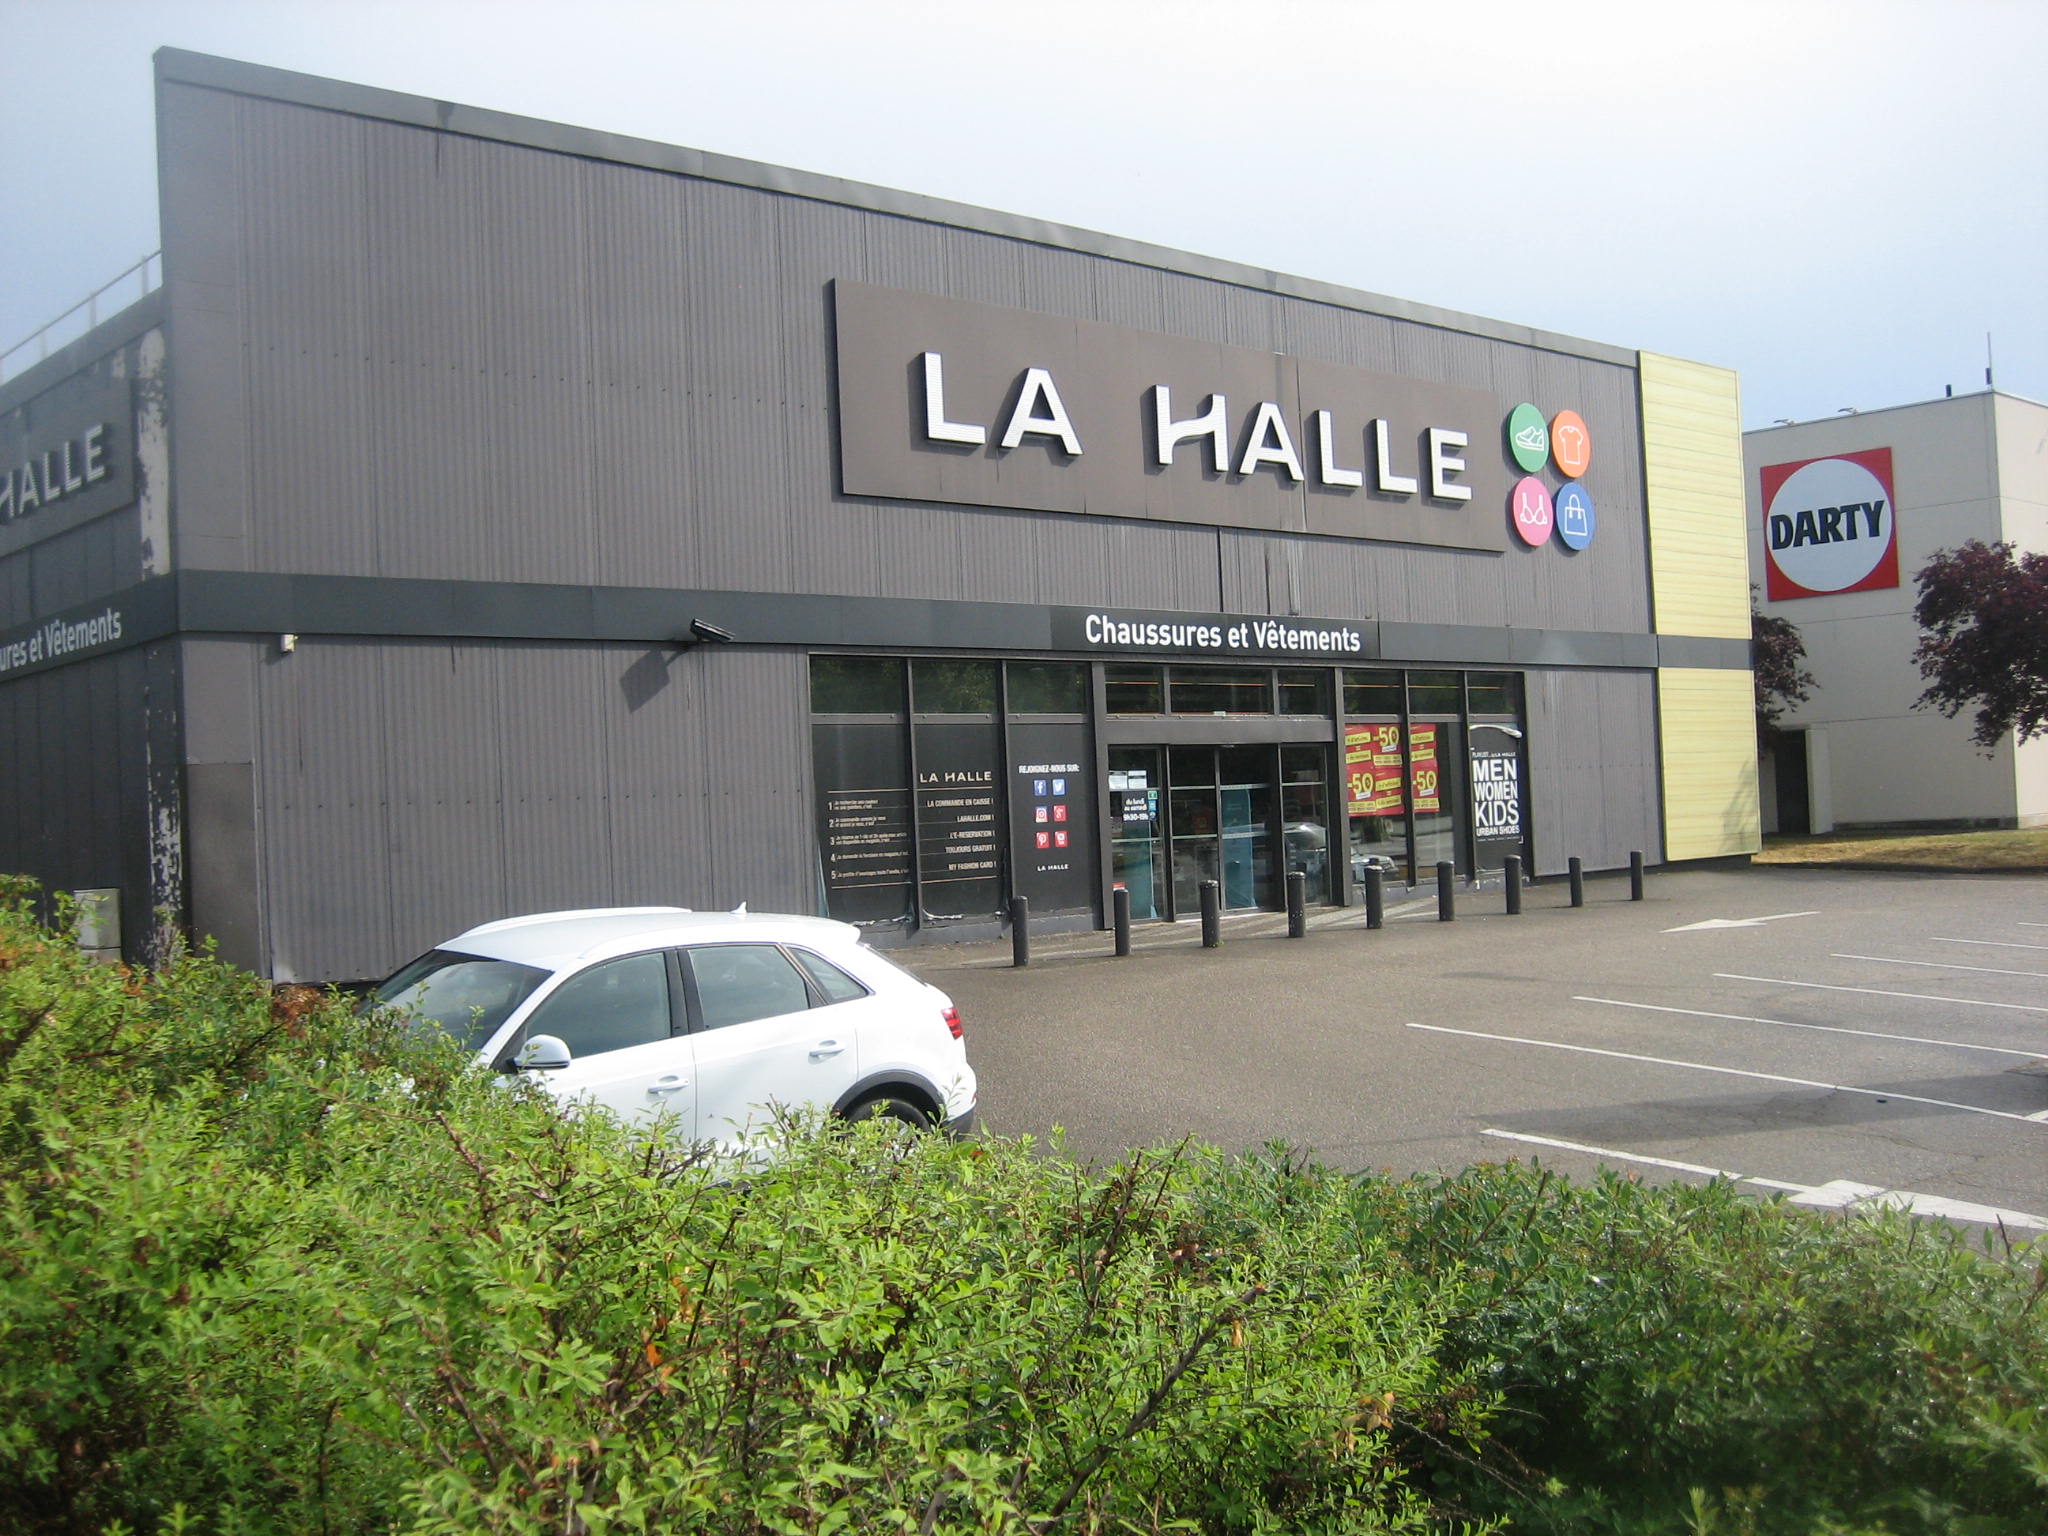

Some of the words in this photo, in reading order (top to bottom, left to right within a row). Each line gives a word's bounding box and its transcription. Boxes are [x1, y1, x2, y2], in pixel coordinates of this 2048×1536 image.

[924, 351, 1084, 455] LA
[1155, 384, 1473, 501] HALLE
[1770, 500, 1885, 551] DARTY
[29, 630, 43, 662] et
[44, 607, 122, 658] Vêtements
[1085, 614, 1222, 648] Chaussures
[1227, 622, 1249, 649] et
[1253, 620, 1361, 652] Vêtements
[919, 772, 939, 783] LA
[944, 771, 992, 782] HALLE
[1472, 759, 1517, 782] MEN
[1474, 781, 1518, 802] WOMEN
[828, 802, 833, 810] 1
[1475, 800, 1520, 827] KIDS
[829, 819, 834, 828] 2
[1476, 826, 1499, 836] URBAN
[1499, 825, 1520, 834] SHOES
[830, 837, 835, 845] 3
[831, 853, 835, 862] 4
[831, 871, 836, 879] 5
